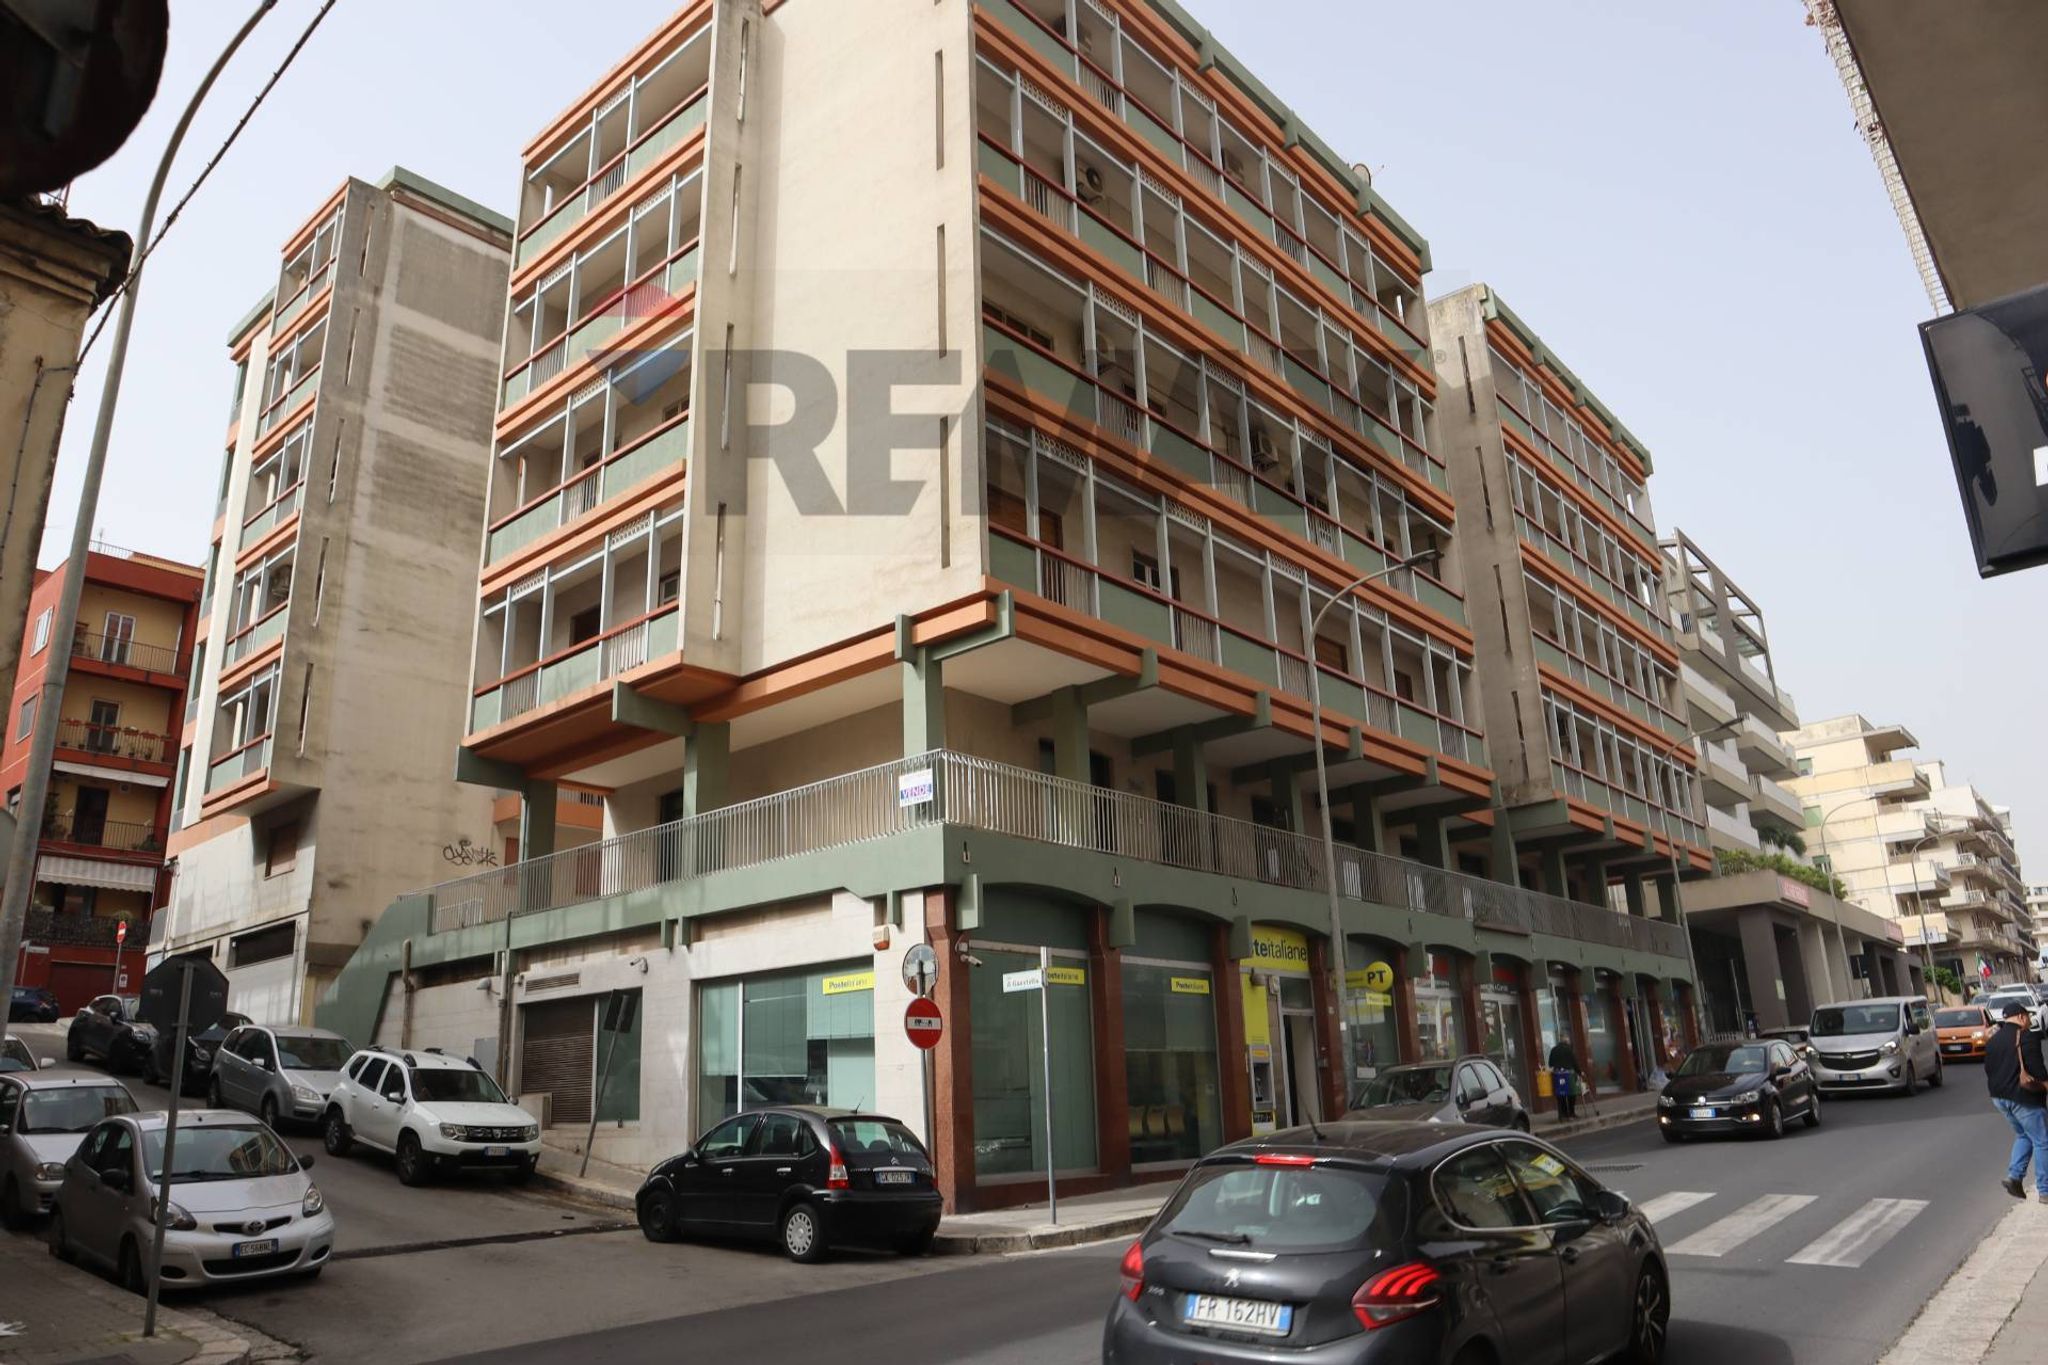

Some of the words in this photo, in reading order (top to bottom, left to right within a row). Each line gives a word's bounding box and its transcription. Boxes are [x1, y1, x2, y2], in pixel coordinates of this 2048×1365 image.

[1251, 938, 1307, 962] teitaliane
[1367, 970, 1387, 985] PT
[1197, 1296, 1217, 1318] FR
[1226, 1299, 1279, 1326] 162HV
